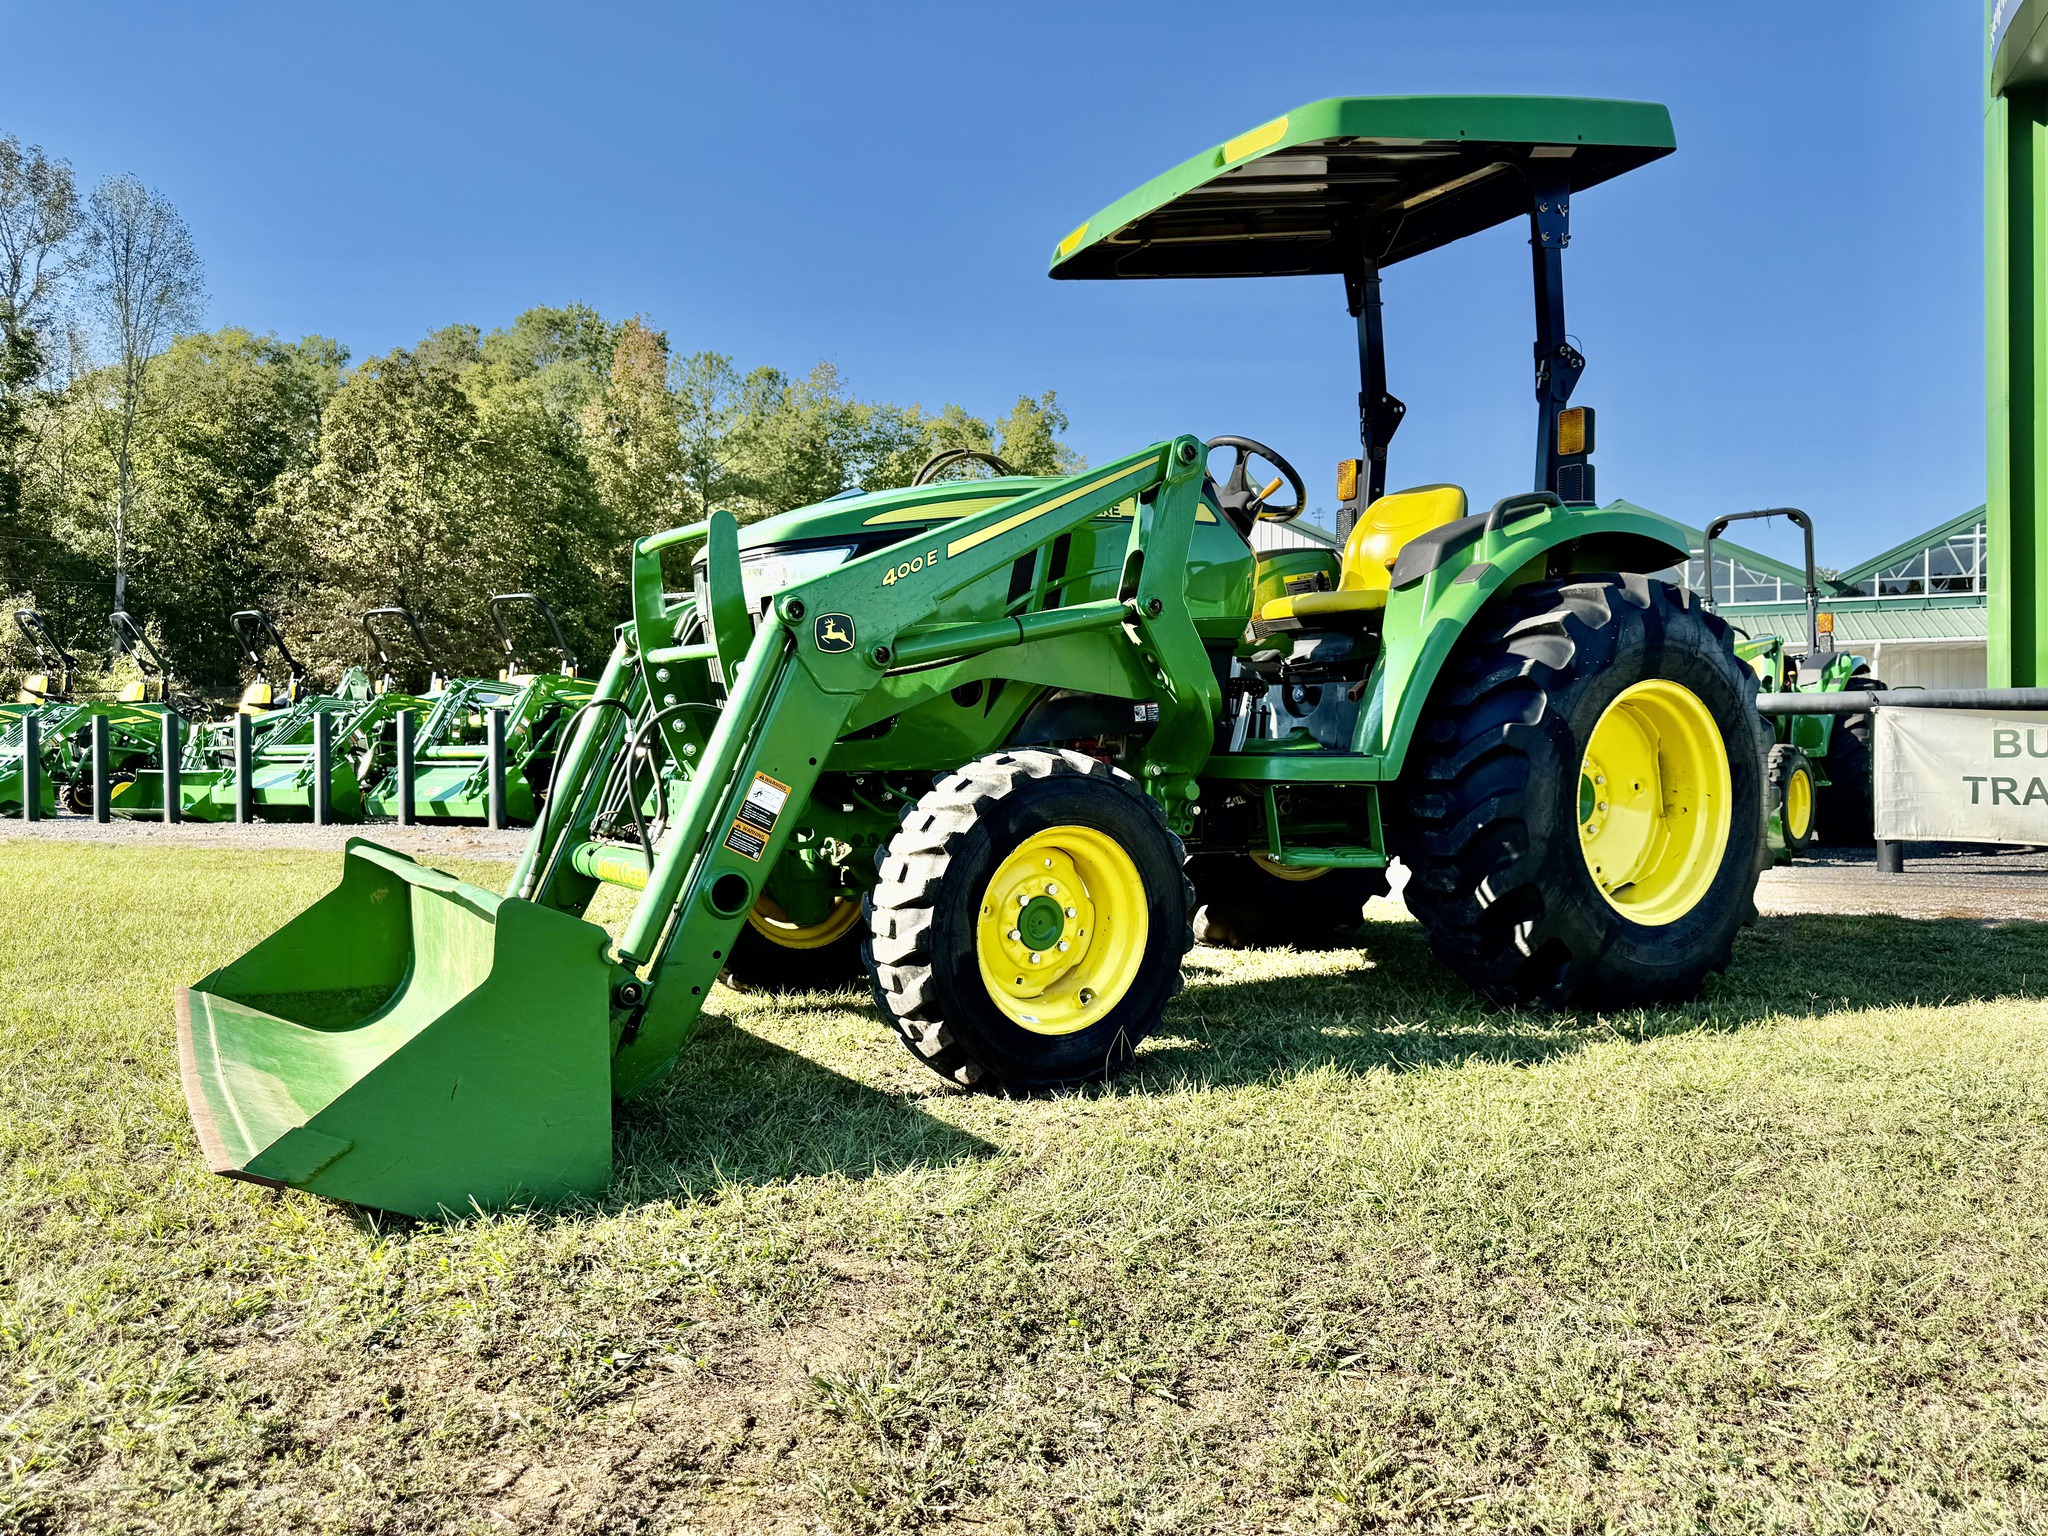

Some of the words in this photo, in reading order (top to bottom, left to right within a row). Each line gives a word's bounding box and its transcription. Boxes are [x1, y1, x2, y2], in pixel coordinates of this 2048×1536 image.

[1993, 729, 2048, 758] BU
[764, 777, 787, 791] WARNING
[1962, 776, 2048, 806] TRA
[742, 825, 765, 840] WARNING
